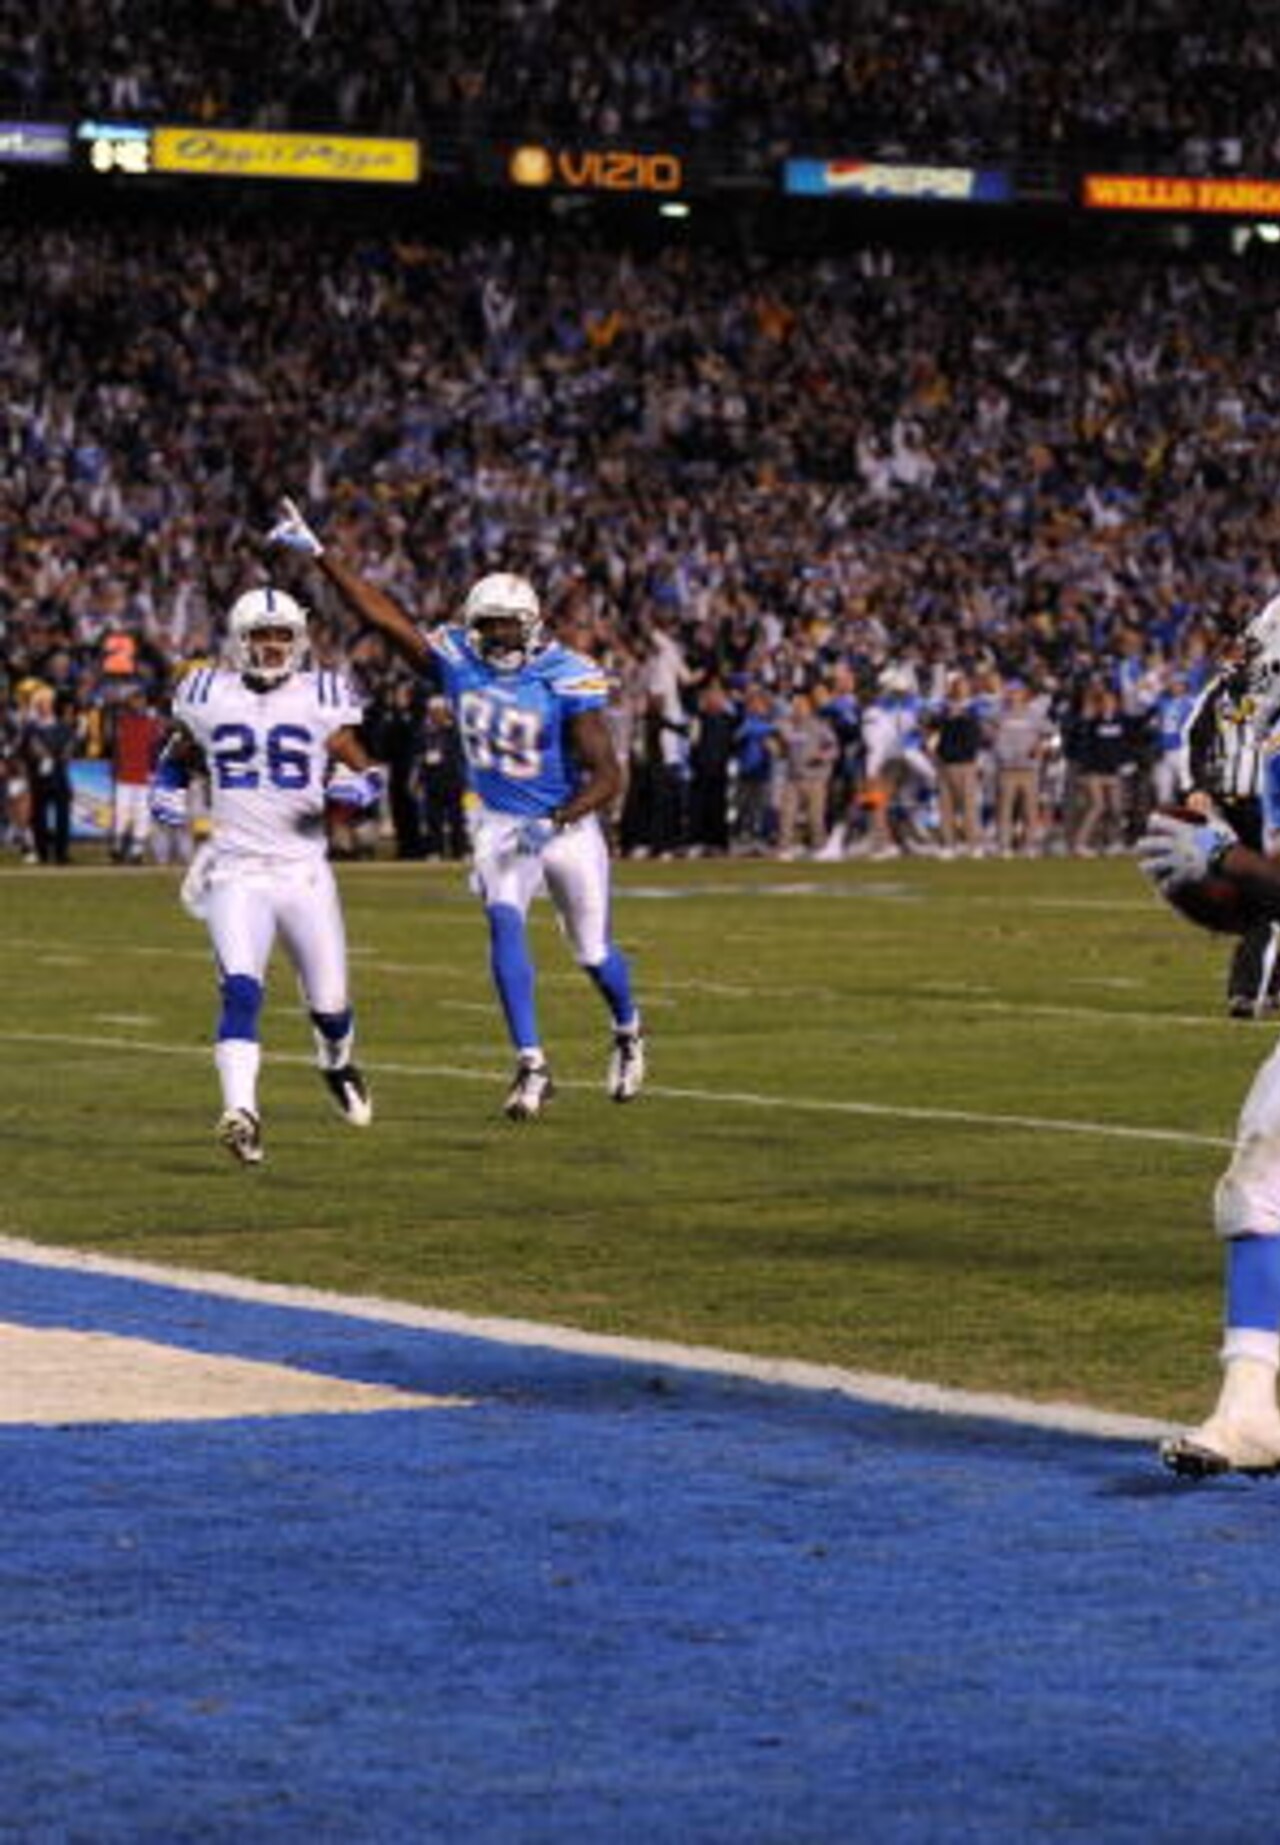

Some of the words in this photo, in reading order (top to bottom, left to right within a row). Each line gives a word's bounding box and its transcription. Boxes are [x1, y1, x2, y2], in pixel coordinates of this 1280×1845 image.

[558, 150, 682, 192] VIZIO
[1084, 175, 1193, 209] WELLS
[211, 723, 314, 790] 26
